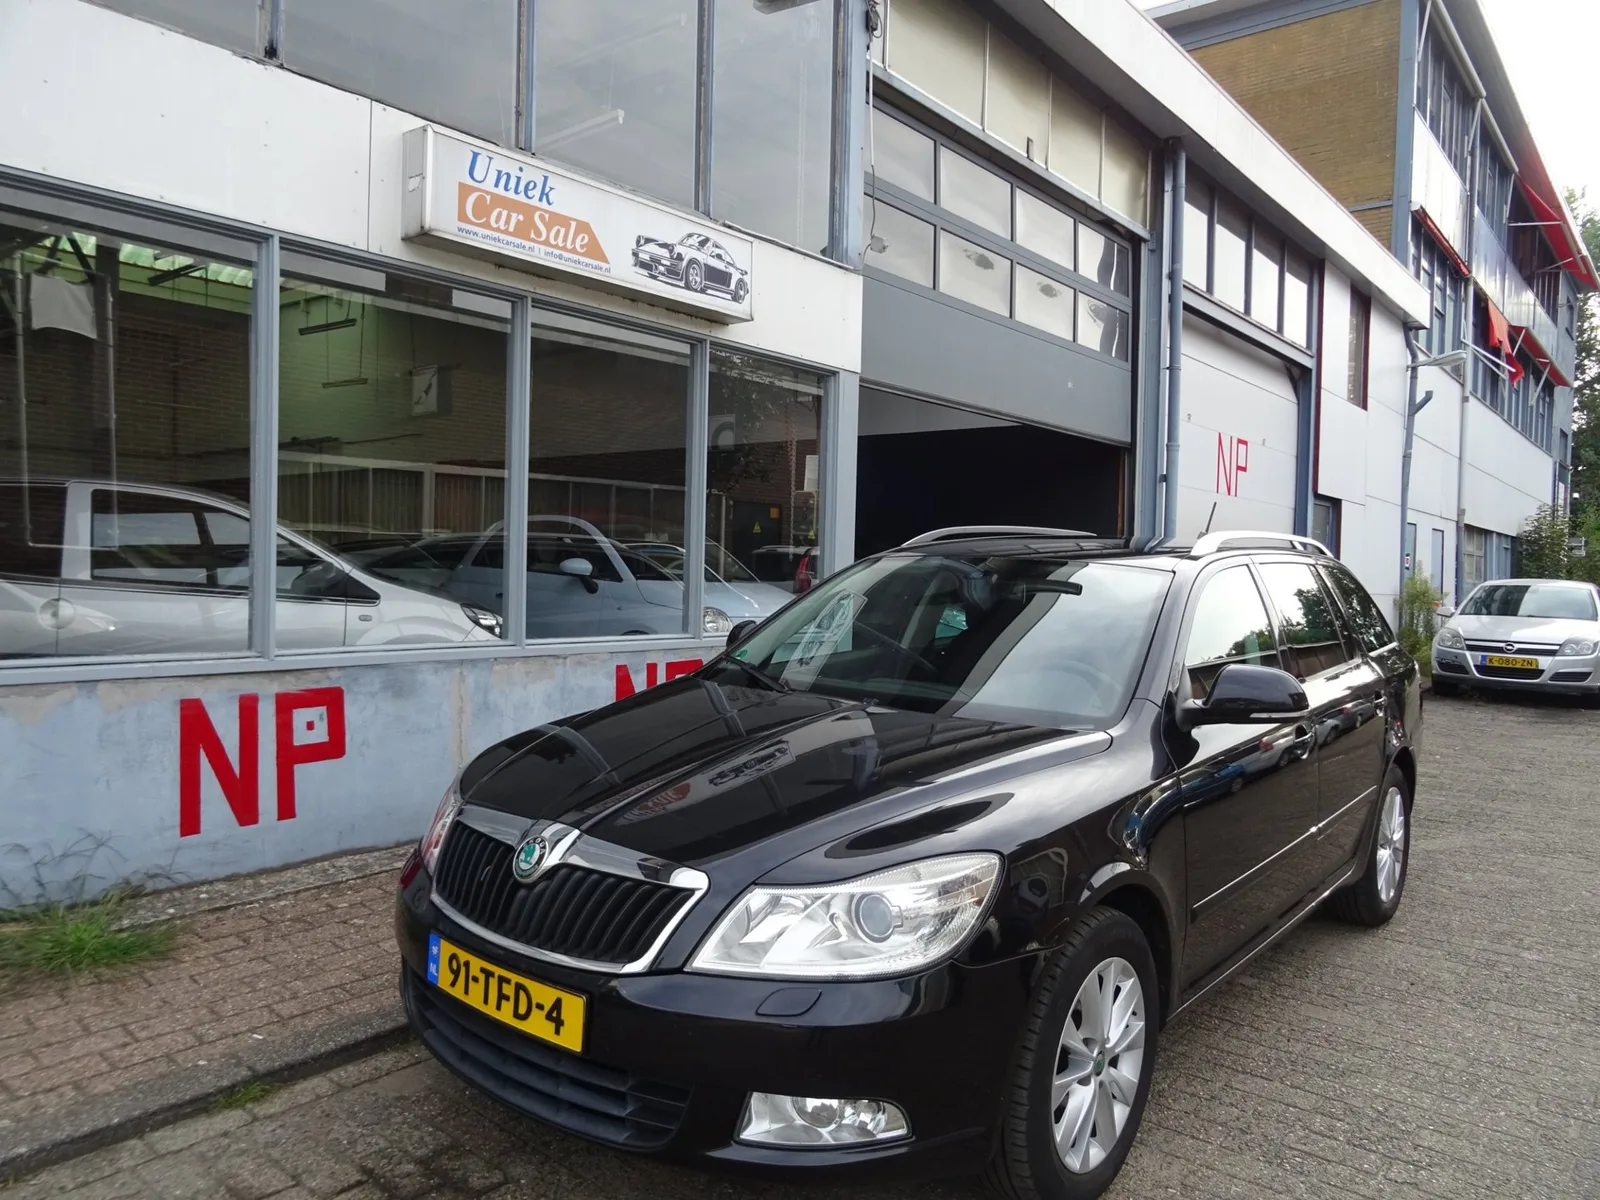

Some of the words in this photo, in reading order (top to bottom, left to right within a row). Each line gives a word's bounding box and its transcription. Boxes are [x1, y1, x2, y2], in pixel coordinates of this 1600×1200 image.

[467, 149, 556, 206] Uniek
[456, 226, 536, 253] www.uniekcarsale.nl
[543, 250, 612, 274] info@uniekcarsale.nl
[465, 191, 525, 233] Car
[530, 210, 590, 253] Sale
[1216, 431, 1249, 498] NP
[1488, 656, 1534, 668] K-080-ZN
[179, 686, 347, 838] NP
[447, 952, 565, 1036] 91-TFD-4
